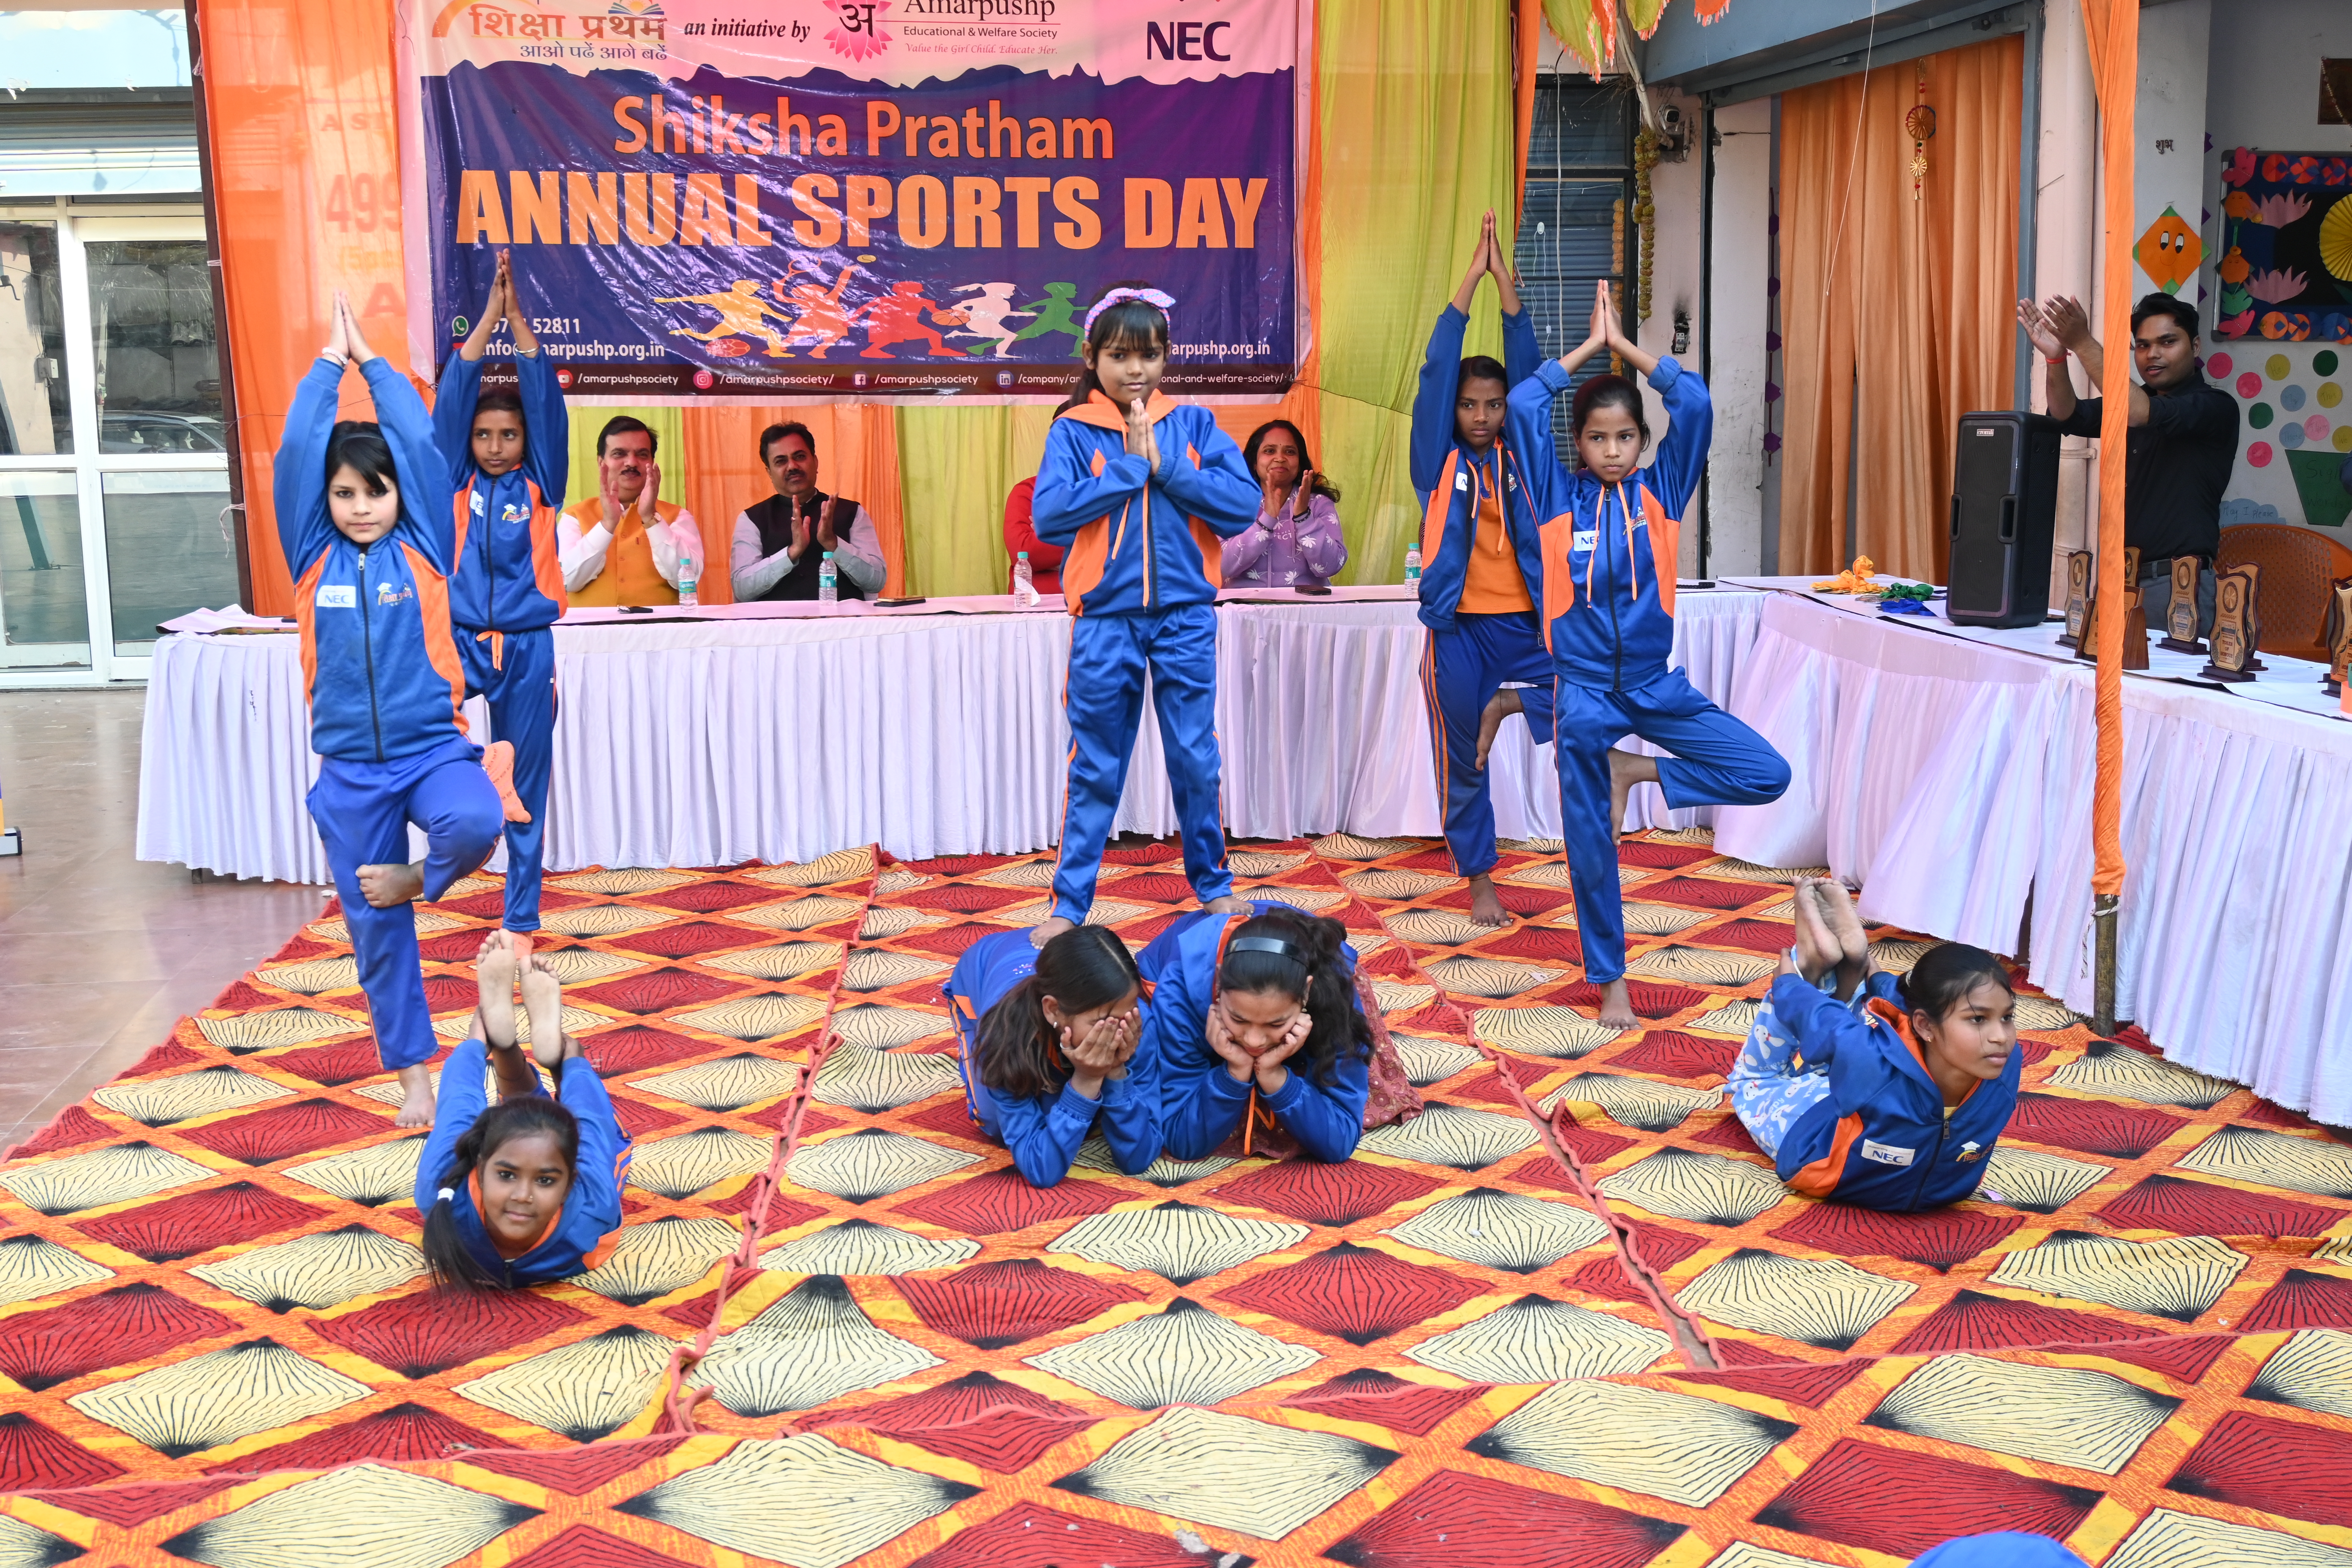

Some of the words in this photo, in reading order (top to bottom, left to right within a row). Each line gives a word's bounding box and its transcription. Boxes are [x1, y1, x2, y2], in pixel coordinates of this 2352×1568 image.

[904, 0, 1055, 22] Amarpushp
[468, 3, 566, 41] शिक्षा
[578, 15, 667, 40] प्रथम
[684, 22, 705, 35] an
[711, 18, 786, 37] initiative
[791, 20, 811, 43] by
[904, 26, 965, 36] Educational
[968, 27, 976, 37] &
[977, 27, 1017, 37] Welfare
[1020, 28, 1057, 40] Society
[905, 43, 931, 53] Value
[934, 44, 948, 53] the
[951, 44, 971, 54] Girl
[971, 44, 996, 54] Child.
[999, 45, 1035, 54] Educate
[1037, 46, 1058, 54] Her.
[1147, 21, 1231, 62] NEC
[520, 41, 564, 58] आओ
[600, 44, 636, 59] आगे
[613, 95, 846, 156] Shiksha
[866, 100, 1114, 159] Pratham
[455, 170, 773, 247] ANNUAL
[791, 173, 1102, 249] SPORTS
[1124, 177, 1269, 249] DAY
[533, 318, 580, 333] 52811
[577, 373, 678, 385] /amarpushpsociety
[719, 374, 834, 386] /amarpushpsociety/
[874, 373, 978, 385] /amarpushpsociety
[324, 595, 349, 604] NEC
[1872, 1150, 1904, 1164] NEC
